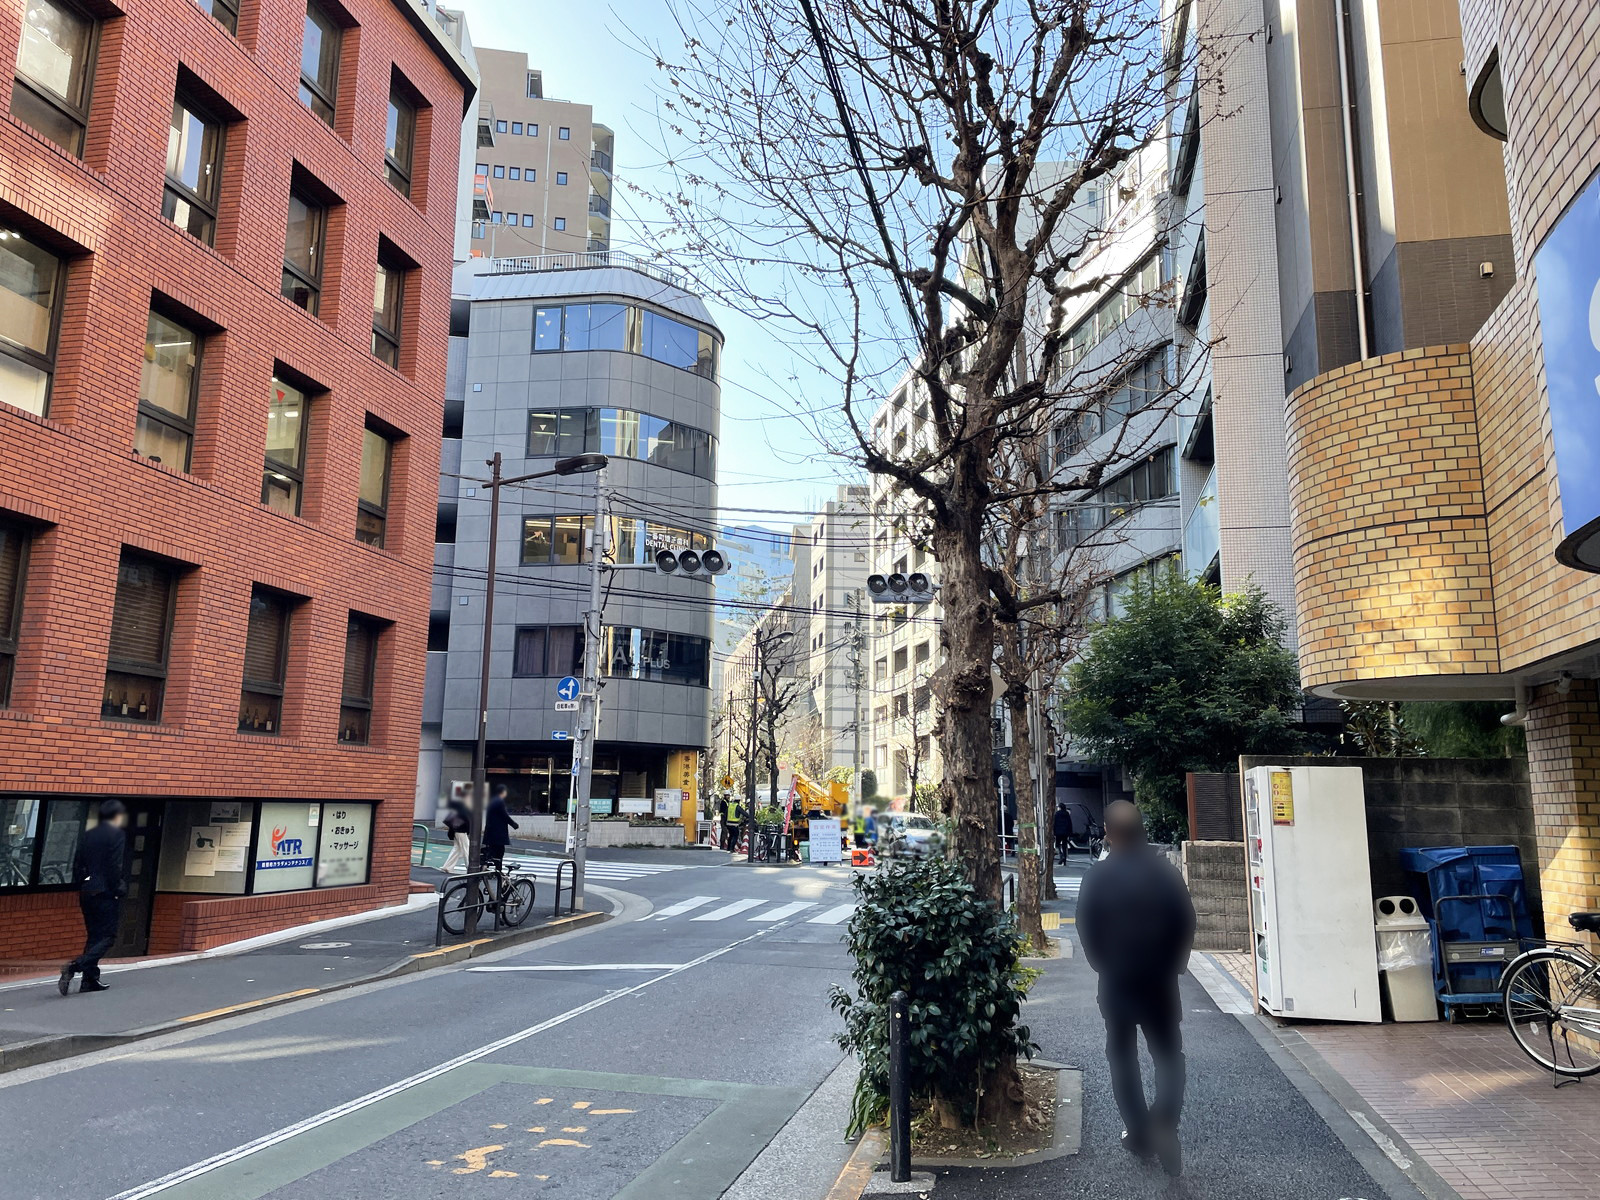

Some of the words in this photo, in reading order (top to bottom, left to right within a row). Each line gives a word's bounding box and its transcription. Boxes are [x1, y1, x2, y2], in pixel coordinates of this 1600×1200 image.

[645, 538, 668, 550] DENTAL
[643, 656, 671, 669] PLUS
[276, 838, 303, 856] ATR
